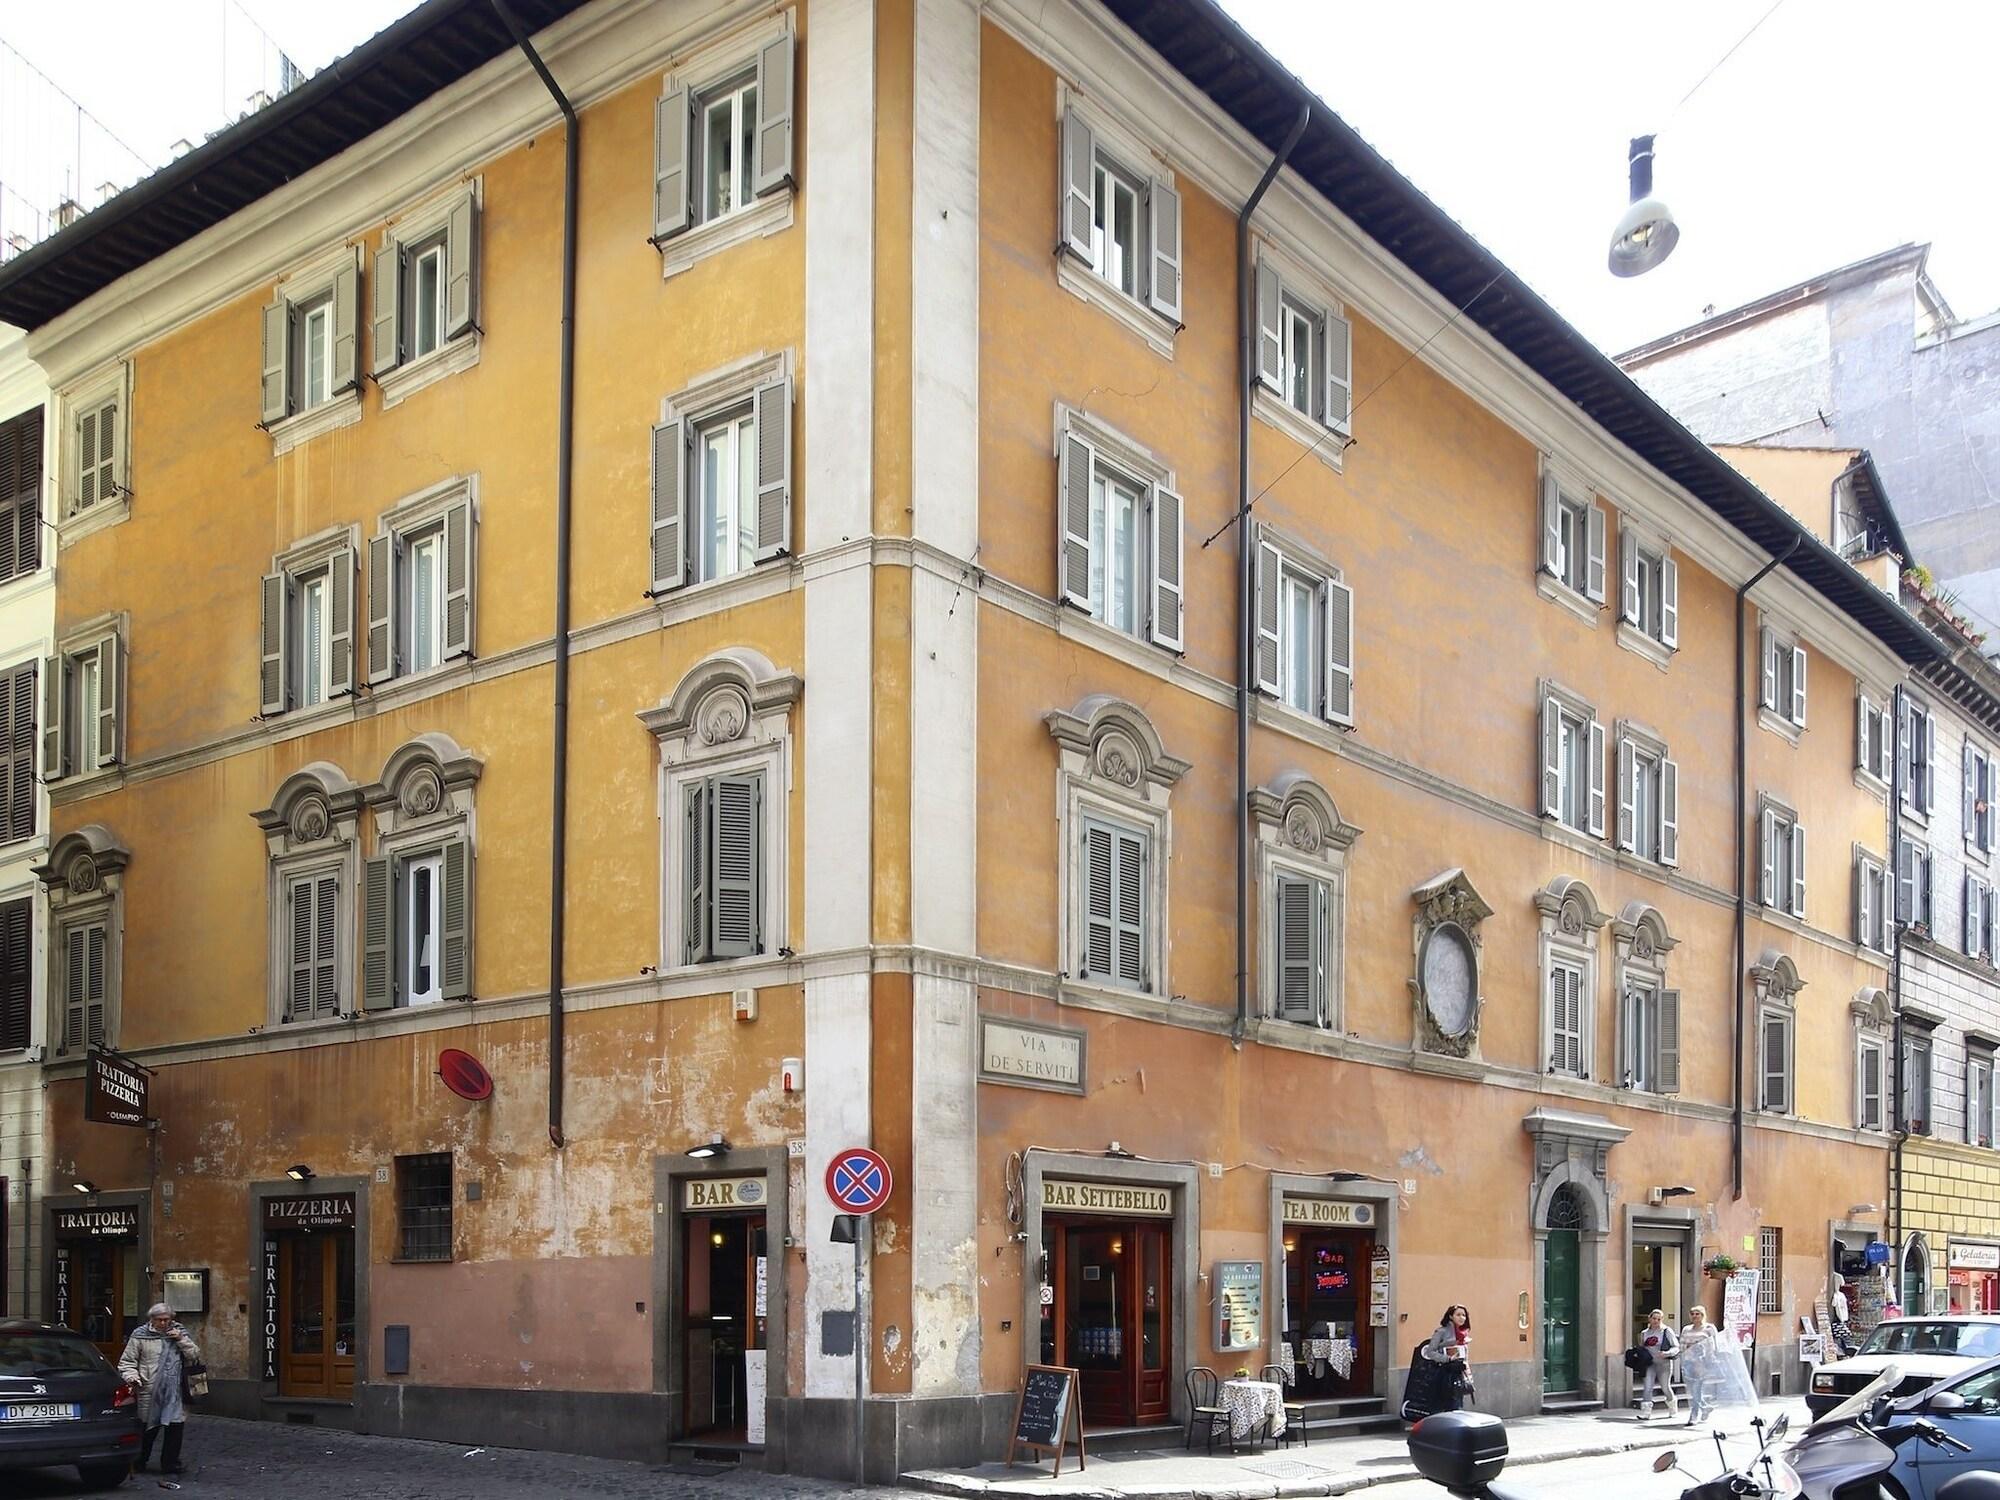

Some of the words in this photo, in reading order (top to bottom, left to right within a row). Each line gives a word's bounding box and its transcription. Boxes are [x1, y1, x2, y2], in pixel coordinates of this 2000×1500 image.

[1021, 1035, 1046, 1053] VIA
[96, 1060, 144, 1094] TRATTORIA
[1017, 1058, 1073, 1079] SERVITI
[101, 1078, 139, 1107] PIZZERIA
[691, 1183, 734, 1205] BAR
[1043, 1183, 1076, 1206] BAR
[1080, 1186, 1167, 1211] SETTEBELLO
[269, 1199, 352, 1217] PIZZERIA
[1283, 1201, 1308, 1220] TEA
[1311, 1202, 1350, 1222] ROOM
[60, 1211, 137, 1228] TRATTORIA
[310, 1216, 342, 1225] Olimpio
[102, 1225, 128, 1235] Olimpio
[1324, 1254, 1344, 1264] BAR
[1960, 1247, 1996, 1260] Gelateria
[265, 1253, 277, 1377] TRATTORIA
[9, 1405, 26, 1418] DY
[32, 1403, 72, 1416] 298LL
